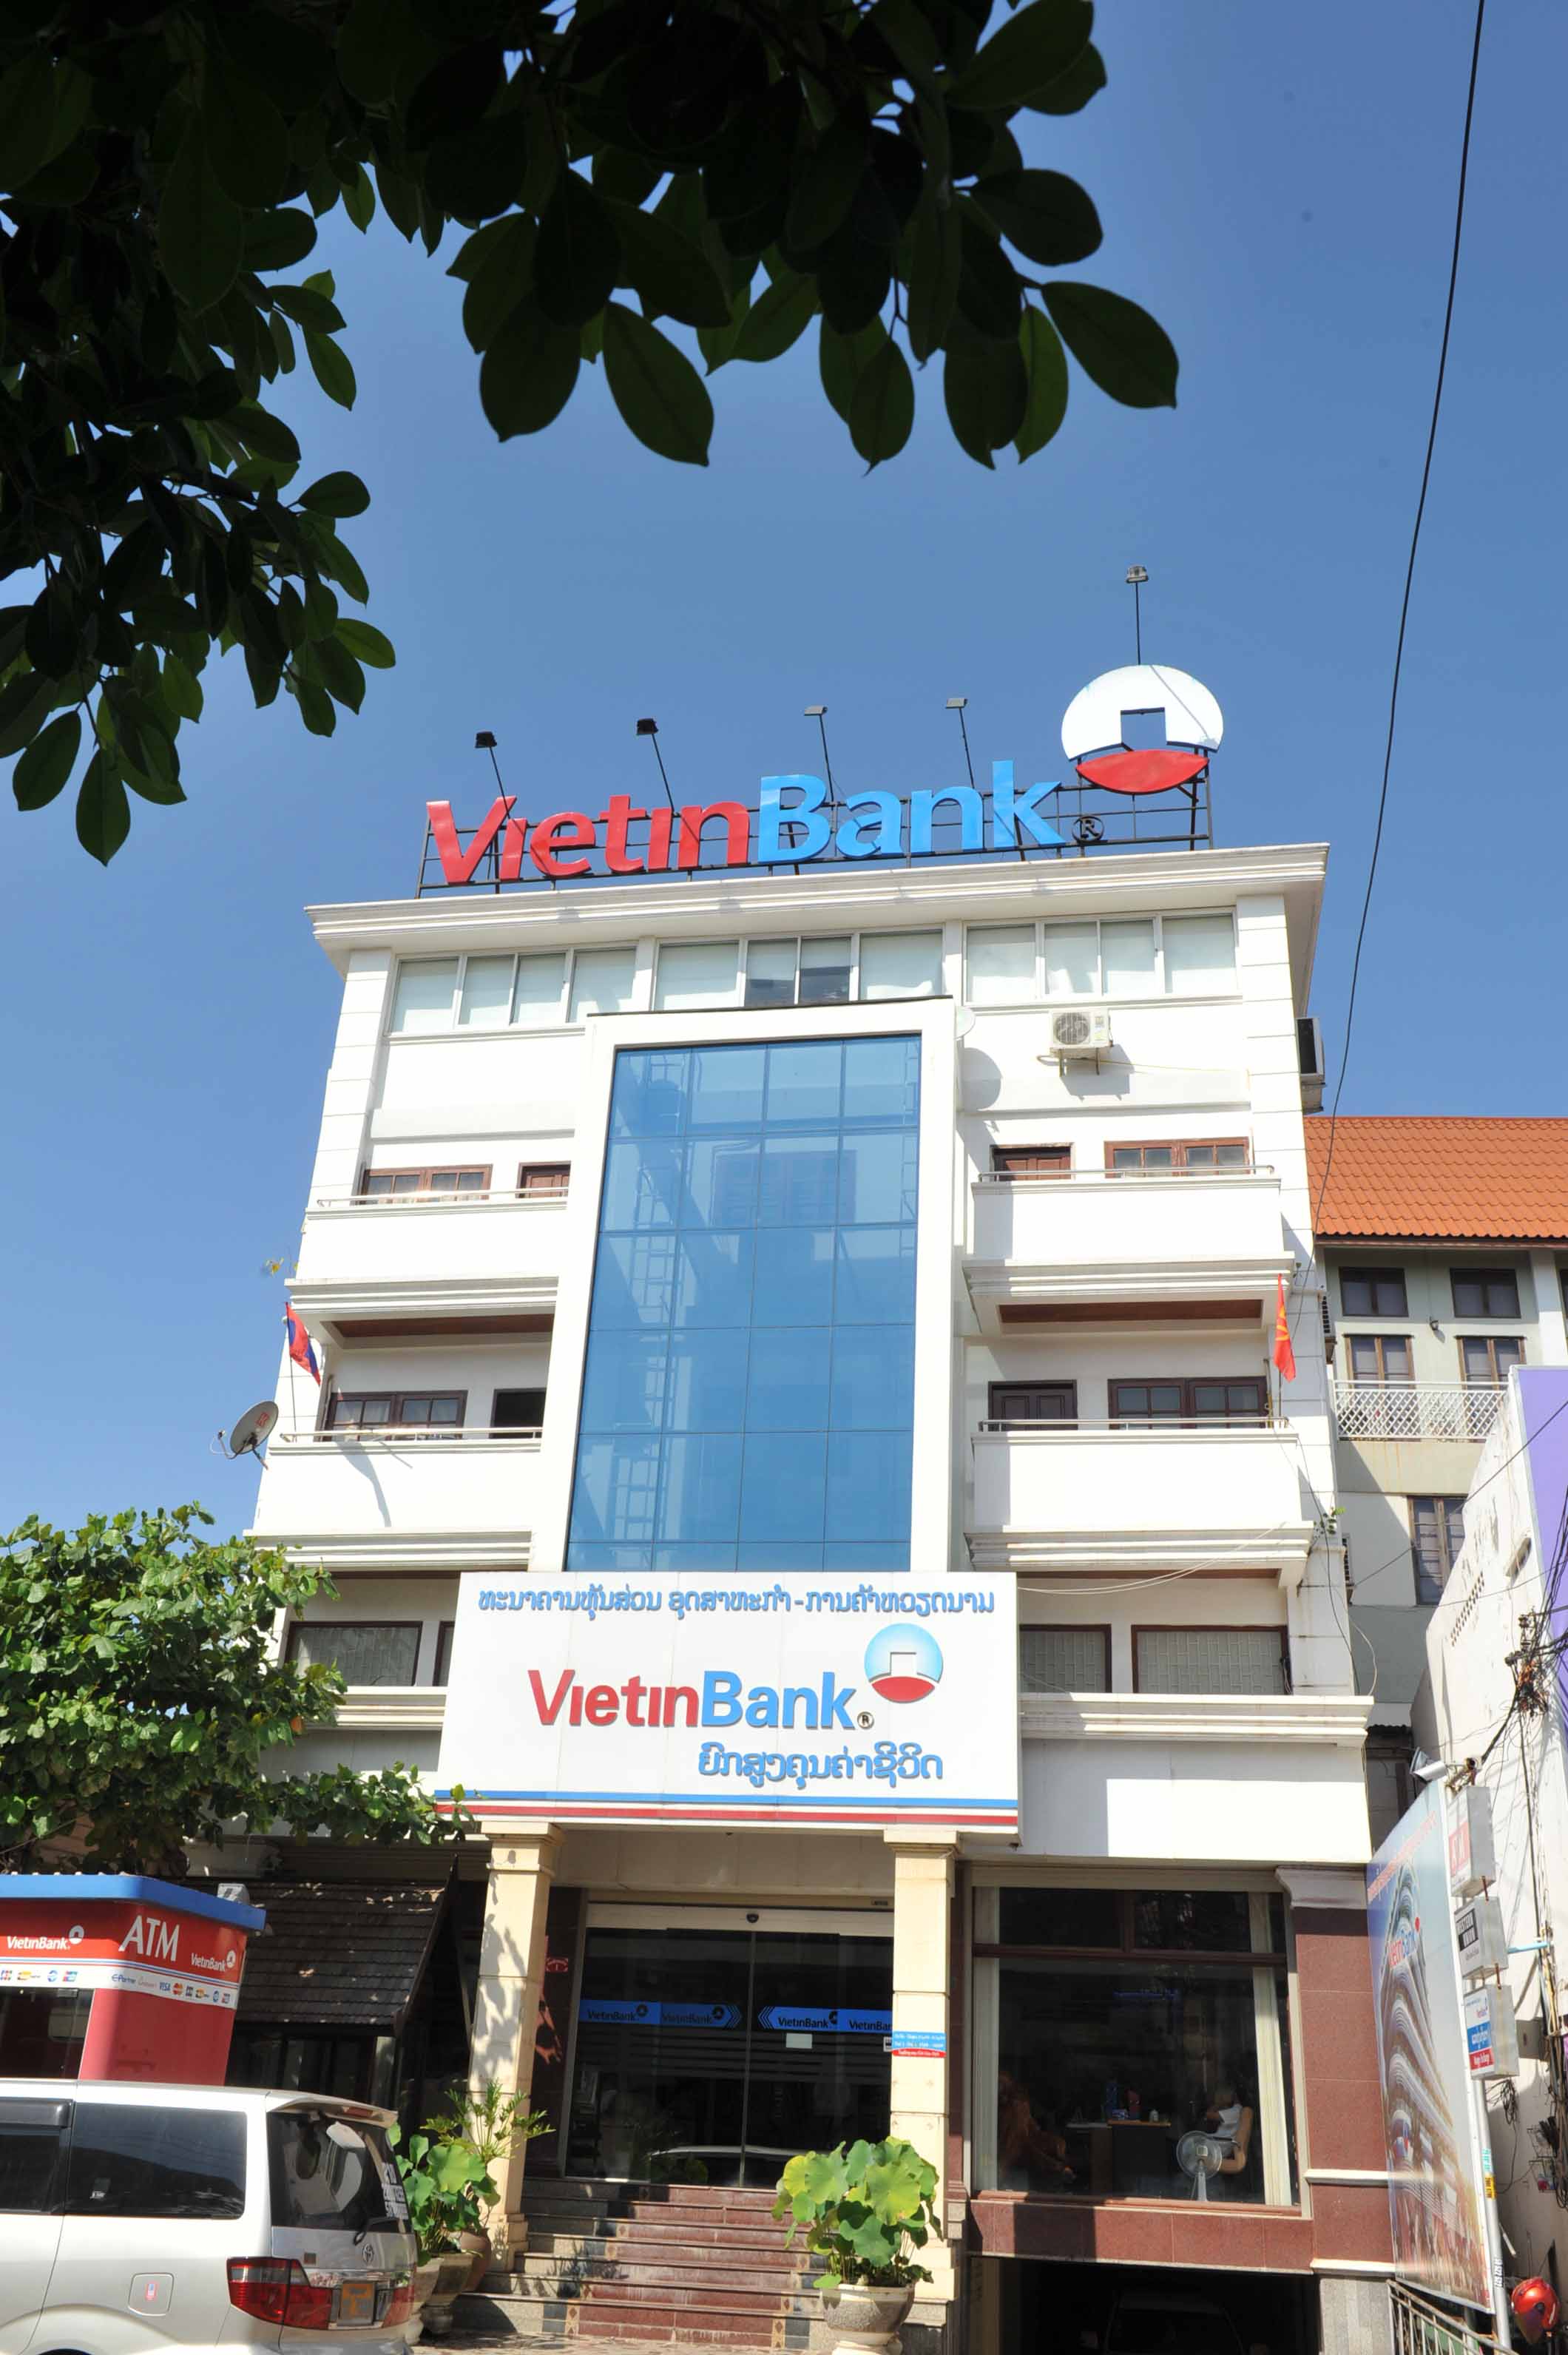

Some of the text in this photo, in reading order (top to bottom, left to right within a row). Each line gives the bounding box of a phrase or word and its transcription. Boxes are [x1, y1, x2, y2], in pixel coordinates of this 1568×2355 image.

[426, 760, 1063, 884] VietinBank
[527, 1669, 856, 1729] VietinBank
[7, 1936, 68, 1950] VietinBank
[118, 1914, 180, 1962] ATM
[778, 2017, 828, 2029] VietinBank
